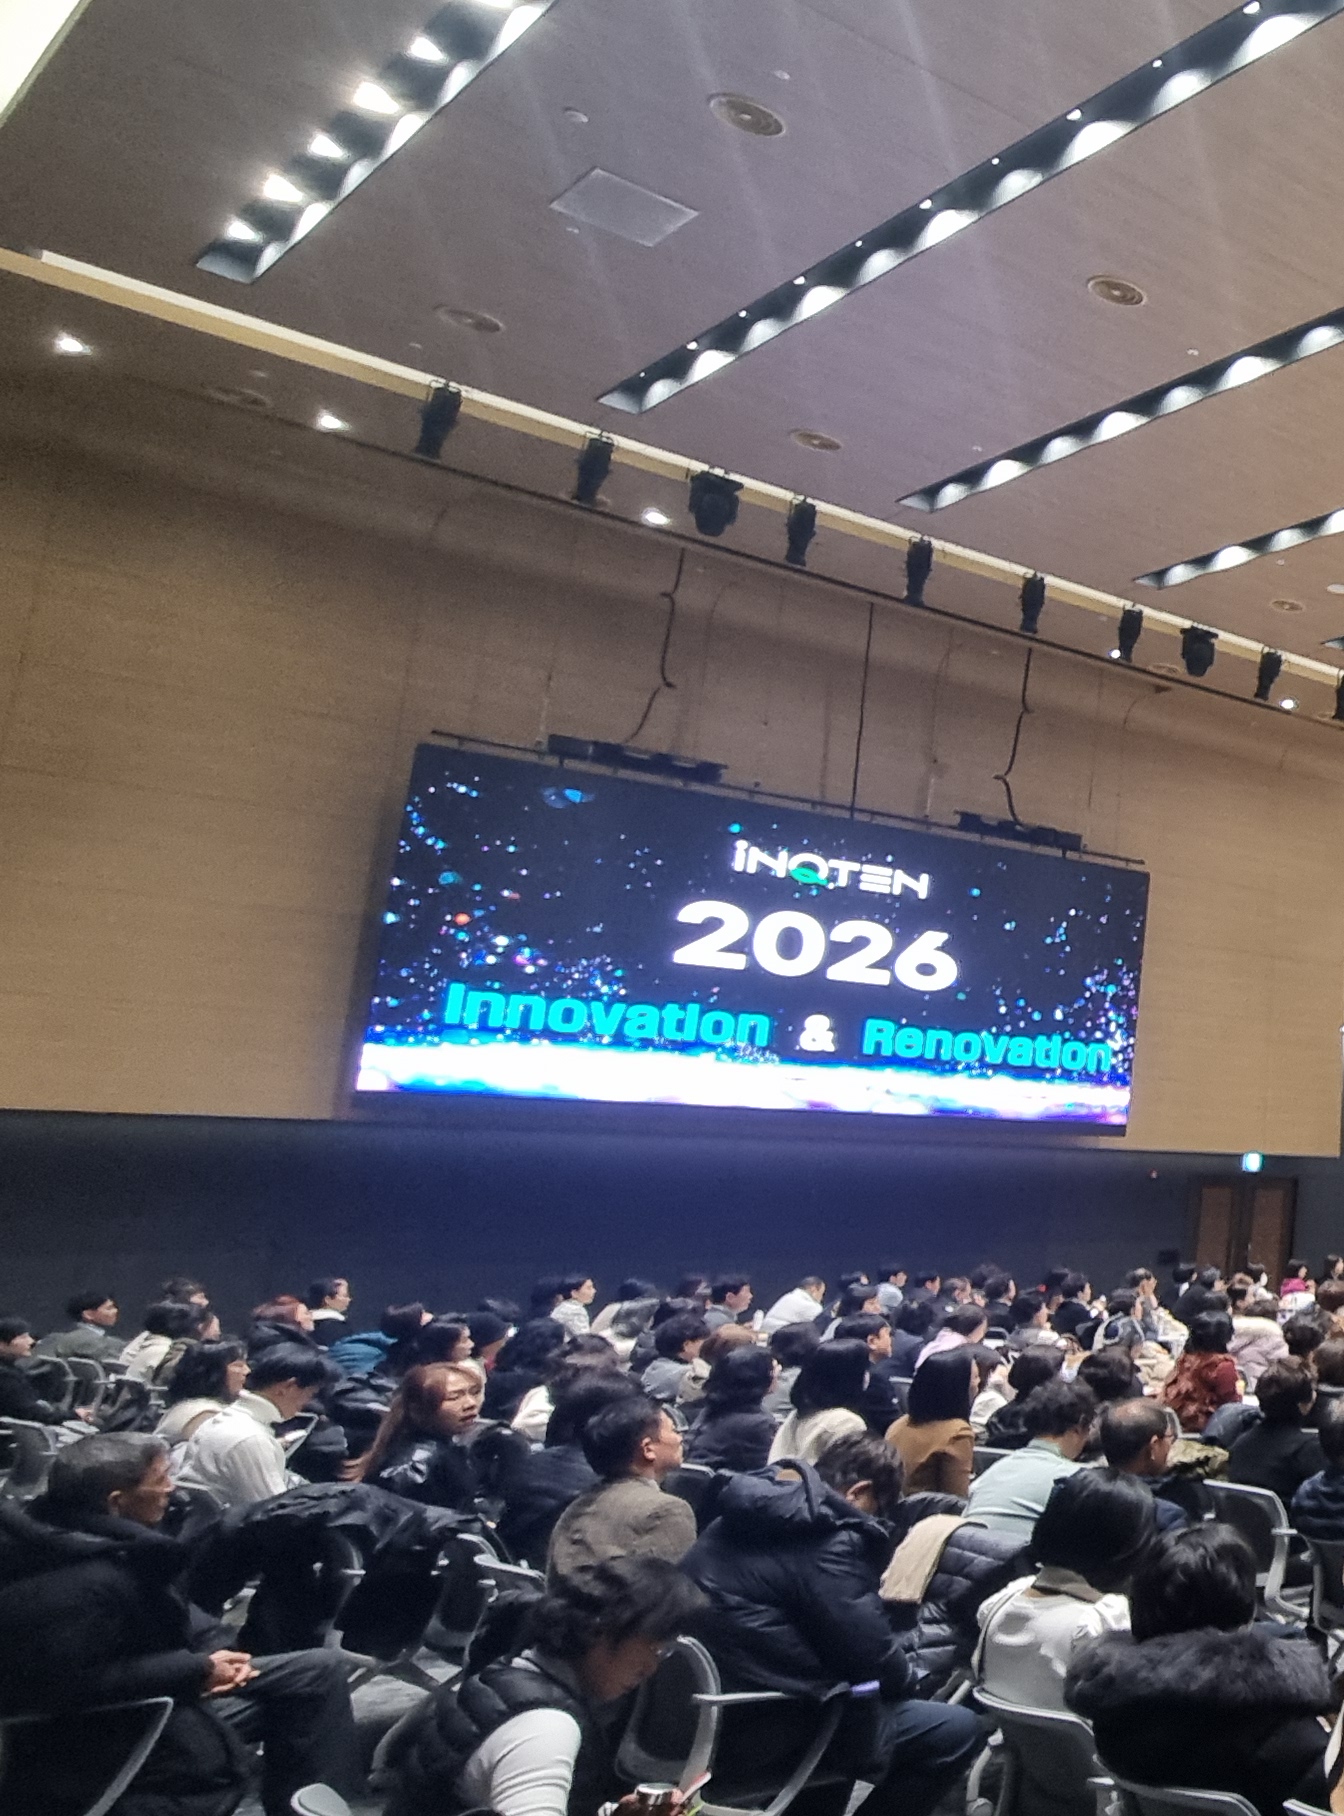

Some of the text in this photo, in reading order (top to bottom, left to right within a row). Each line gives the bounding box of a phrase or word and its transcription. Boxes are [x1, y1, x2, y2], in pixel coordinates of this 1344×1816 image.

[672, 900, 960, 992] 2026
[443, 982, 1111, 1073] Innovation & Renovation
